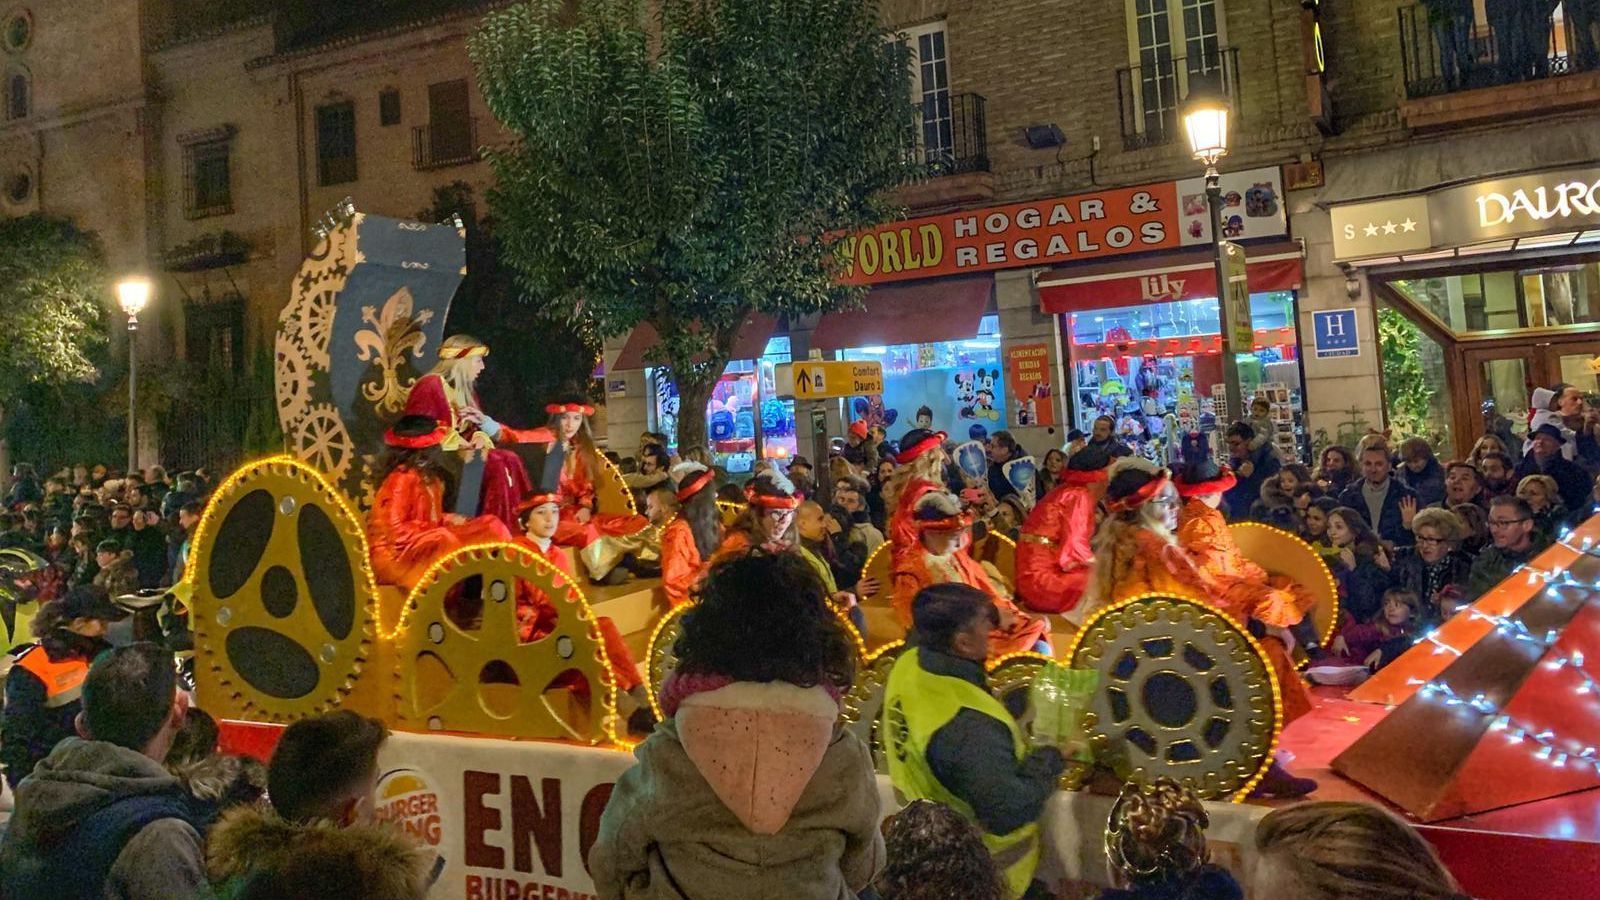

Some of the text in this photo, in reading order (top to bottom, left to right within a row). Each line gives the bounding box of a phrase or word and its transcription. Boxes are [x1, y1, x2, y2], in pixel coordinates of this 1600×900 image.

[954, 191, 1161, 239] HOGAR &
[956, 221, 1166, 267] REGALOS
[1344, 223, 1356, 240] S
[833, 223, 943, 278] WORLD
[1324, 314, 1345, 336] H
[852, 366, 880, 376] Comfort
[854, 381, 875, 392] Dauro
[375, 792, 438, 823] BURGER
[400, 814, 441, 846] NG
[464, 770, 562, 878] EN
